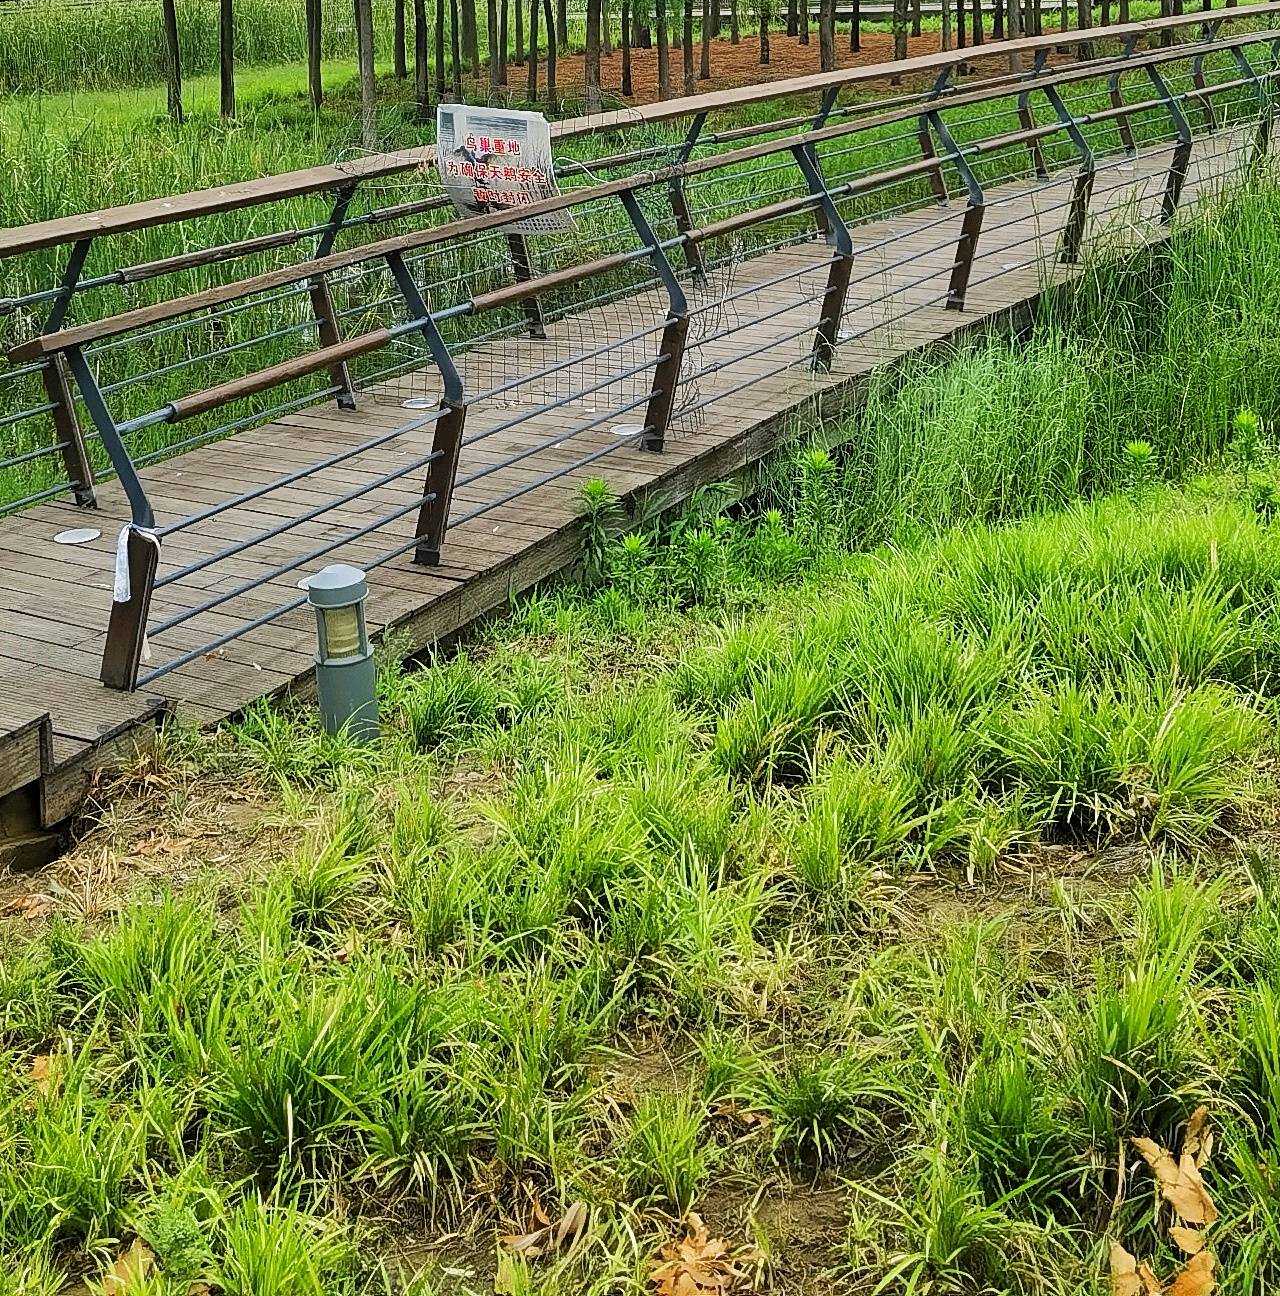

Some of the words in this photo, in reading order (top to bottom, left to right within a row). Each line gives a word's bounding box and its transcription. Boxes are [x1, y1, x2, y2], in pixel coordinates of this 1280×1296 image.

[448, 161, 546, 184] 为确保天鹅安全
